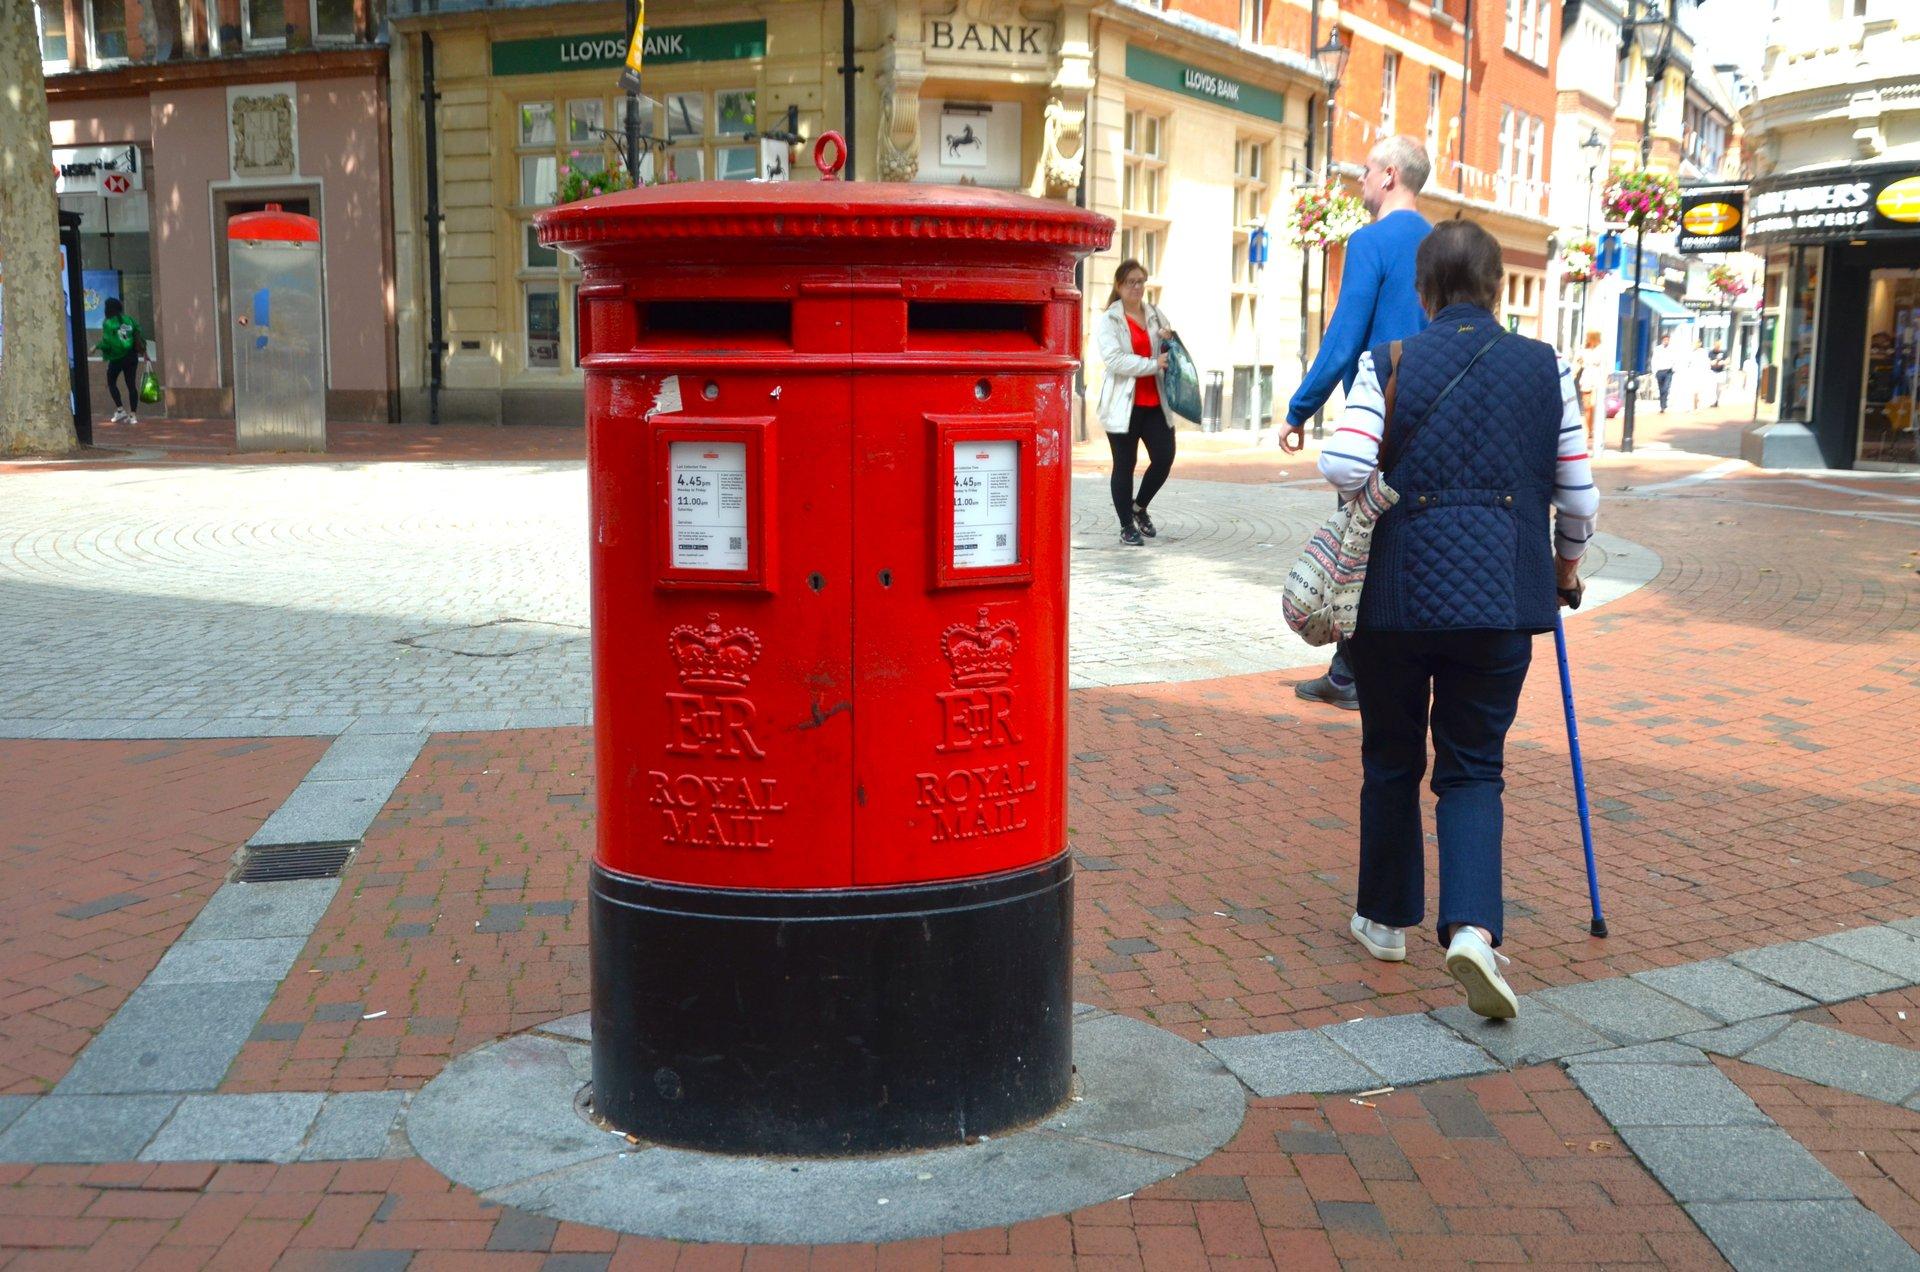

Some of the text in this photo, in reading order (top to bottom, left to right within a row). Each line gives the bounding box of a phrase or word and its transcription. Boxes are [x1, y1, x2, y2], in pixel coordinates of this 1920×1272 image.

[561, 38, 626, 62] LLOYDS
[643, 34, 684, 56] ANK
[931, 21, 1042, 54] BANK
[1184, 67, 1240, 101] LLOYDS BANK
[677, 473, 711, 486] 4.45pm
[954, 475, 982, 487] 4.45pm
[677, 496, 709, 506] 11.00am
[648, 770, 789, 811] ROYAL
[914, 760, 1038, 806] ROYAL
[662, 808, 775, 848] MAIL
[930, 797, 1028, 842] MAIL
